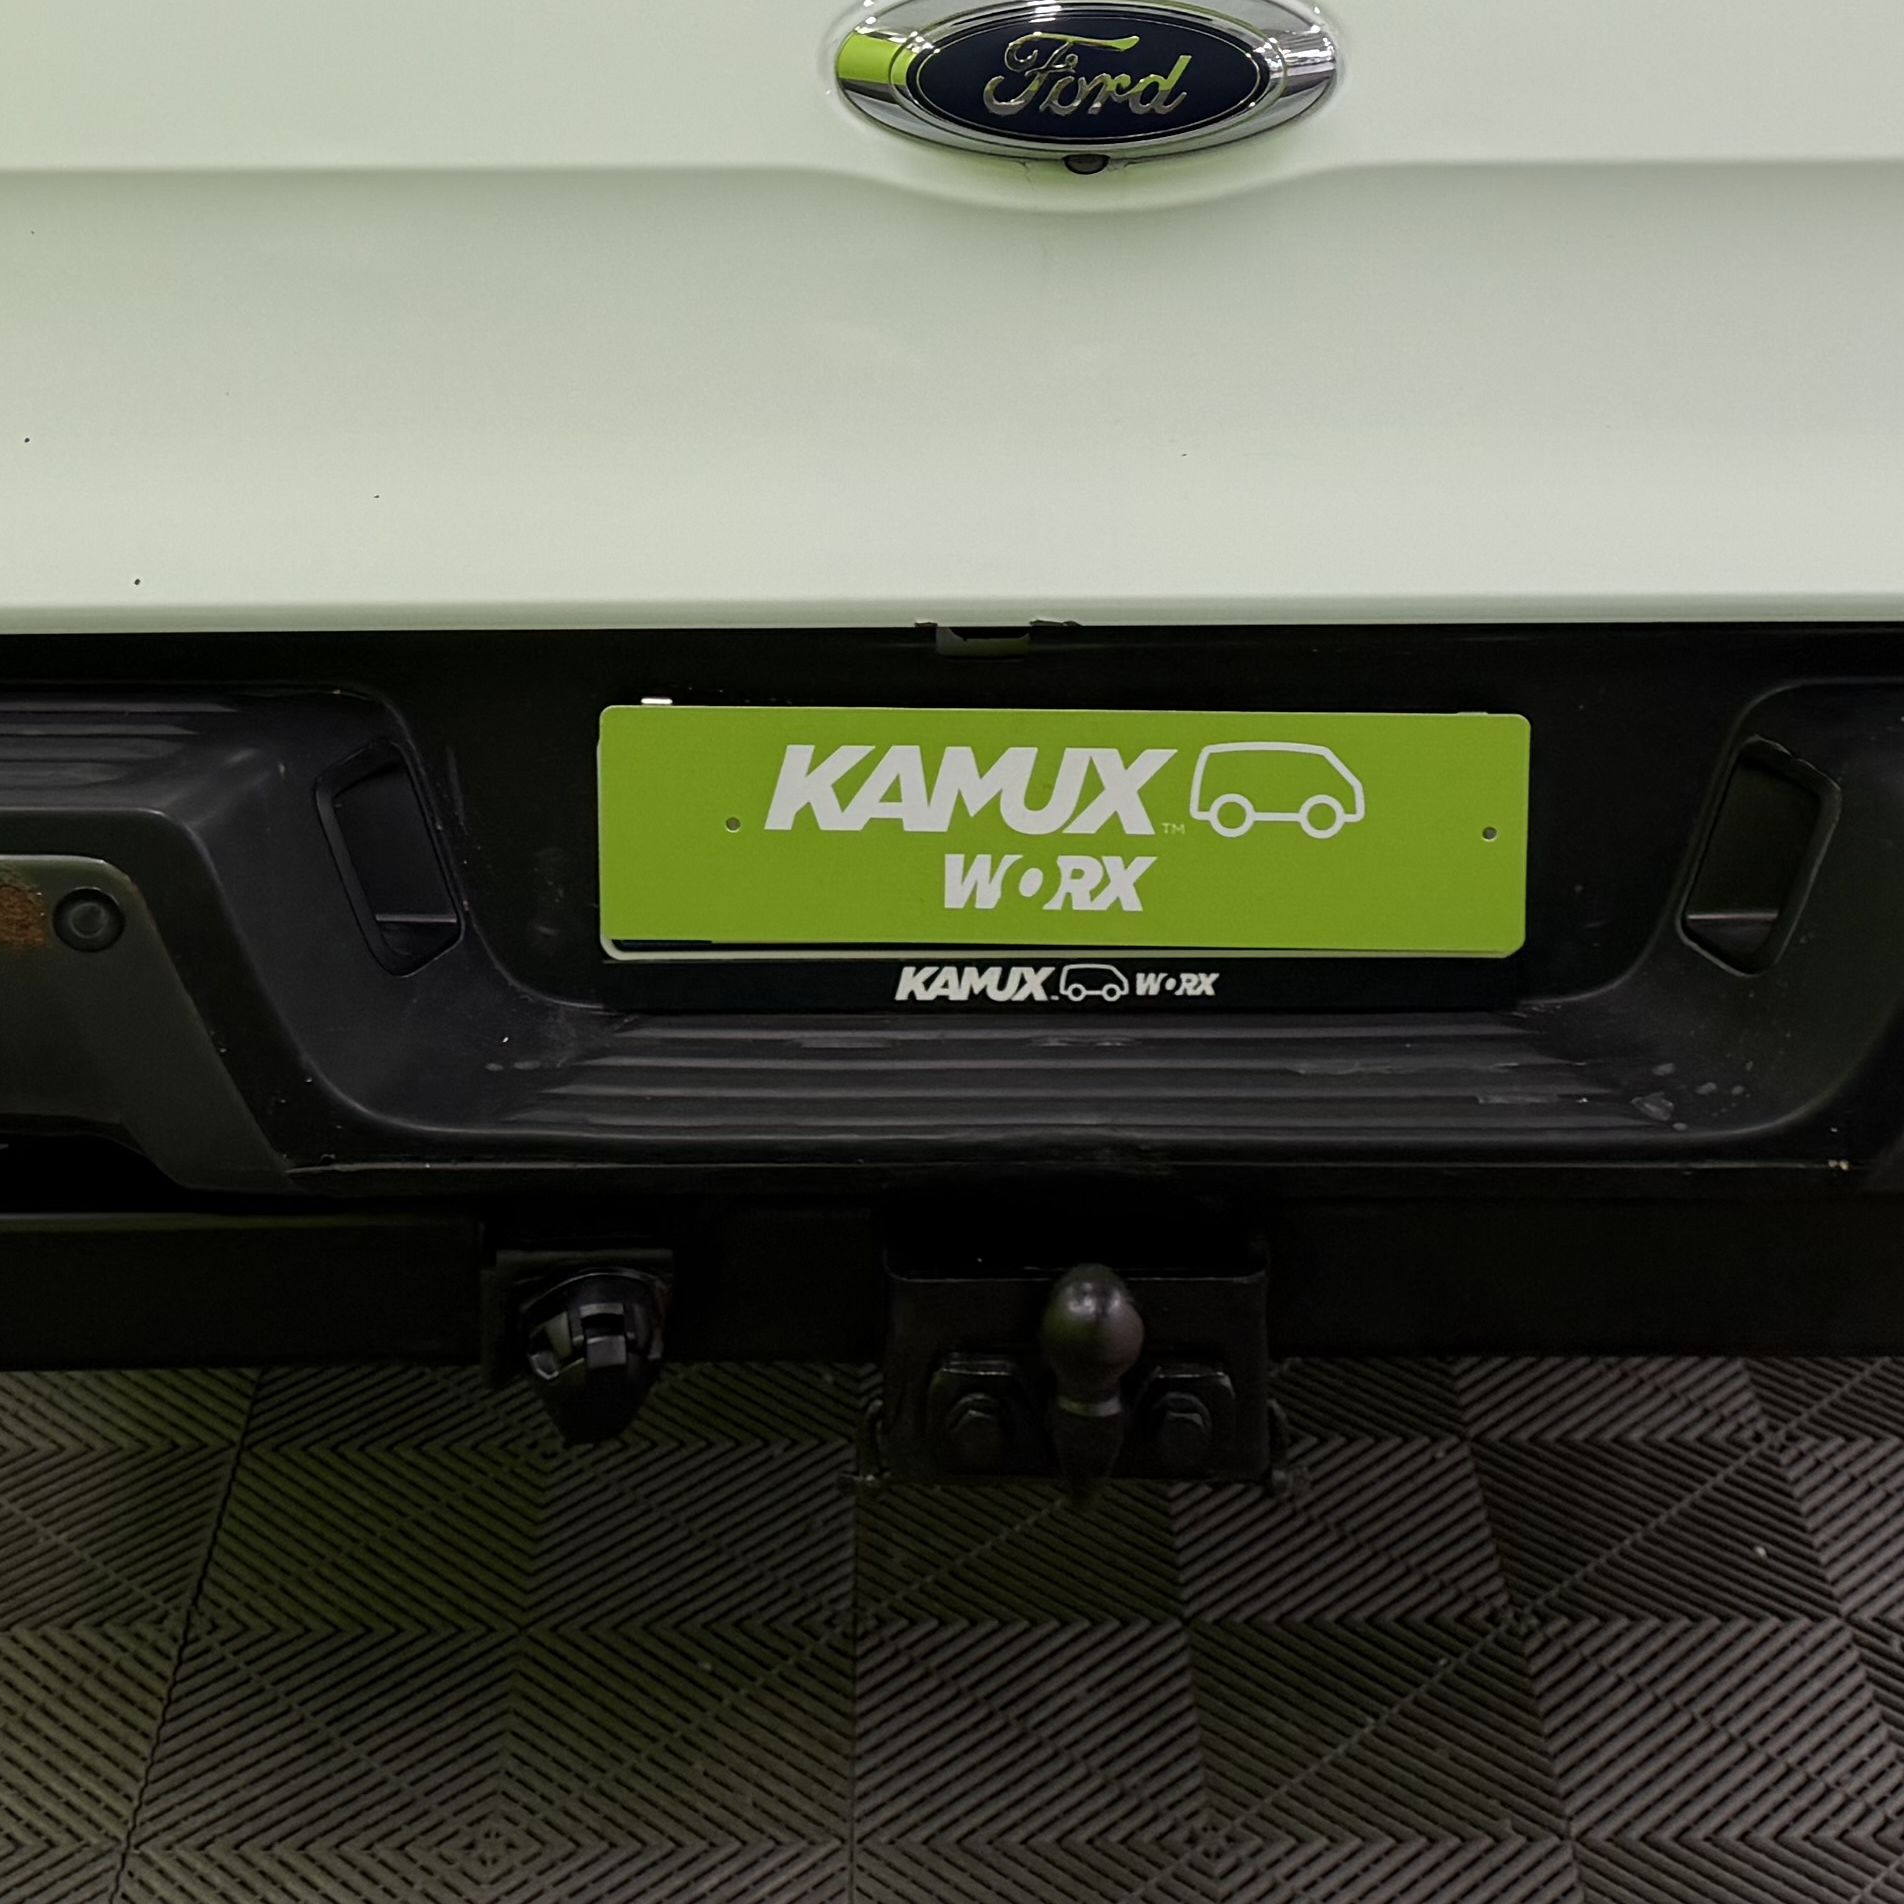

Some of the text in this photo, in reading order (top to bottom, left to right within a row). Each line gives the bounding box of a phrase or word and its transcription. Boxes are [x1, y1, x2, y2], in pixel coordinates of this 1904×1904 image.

[983, 31, 1192, 116] Ford
[764, 744, 1179, 835] KAMUX
[944, 853, 1158, 912] WORX
[894, 965, 1220, 1002] KAMUX WORX
